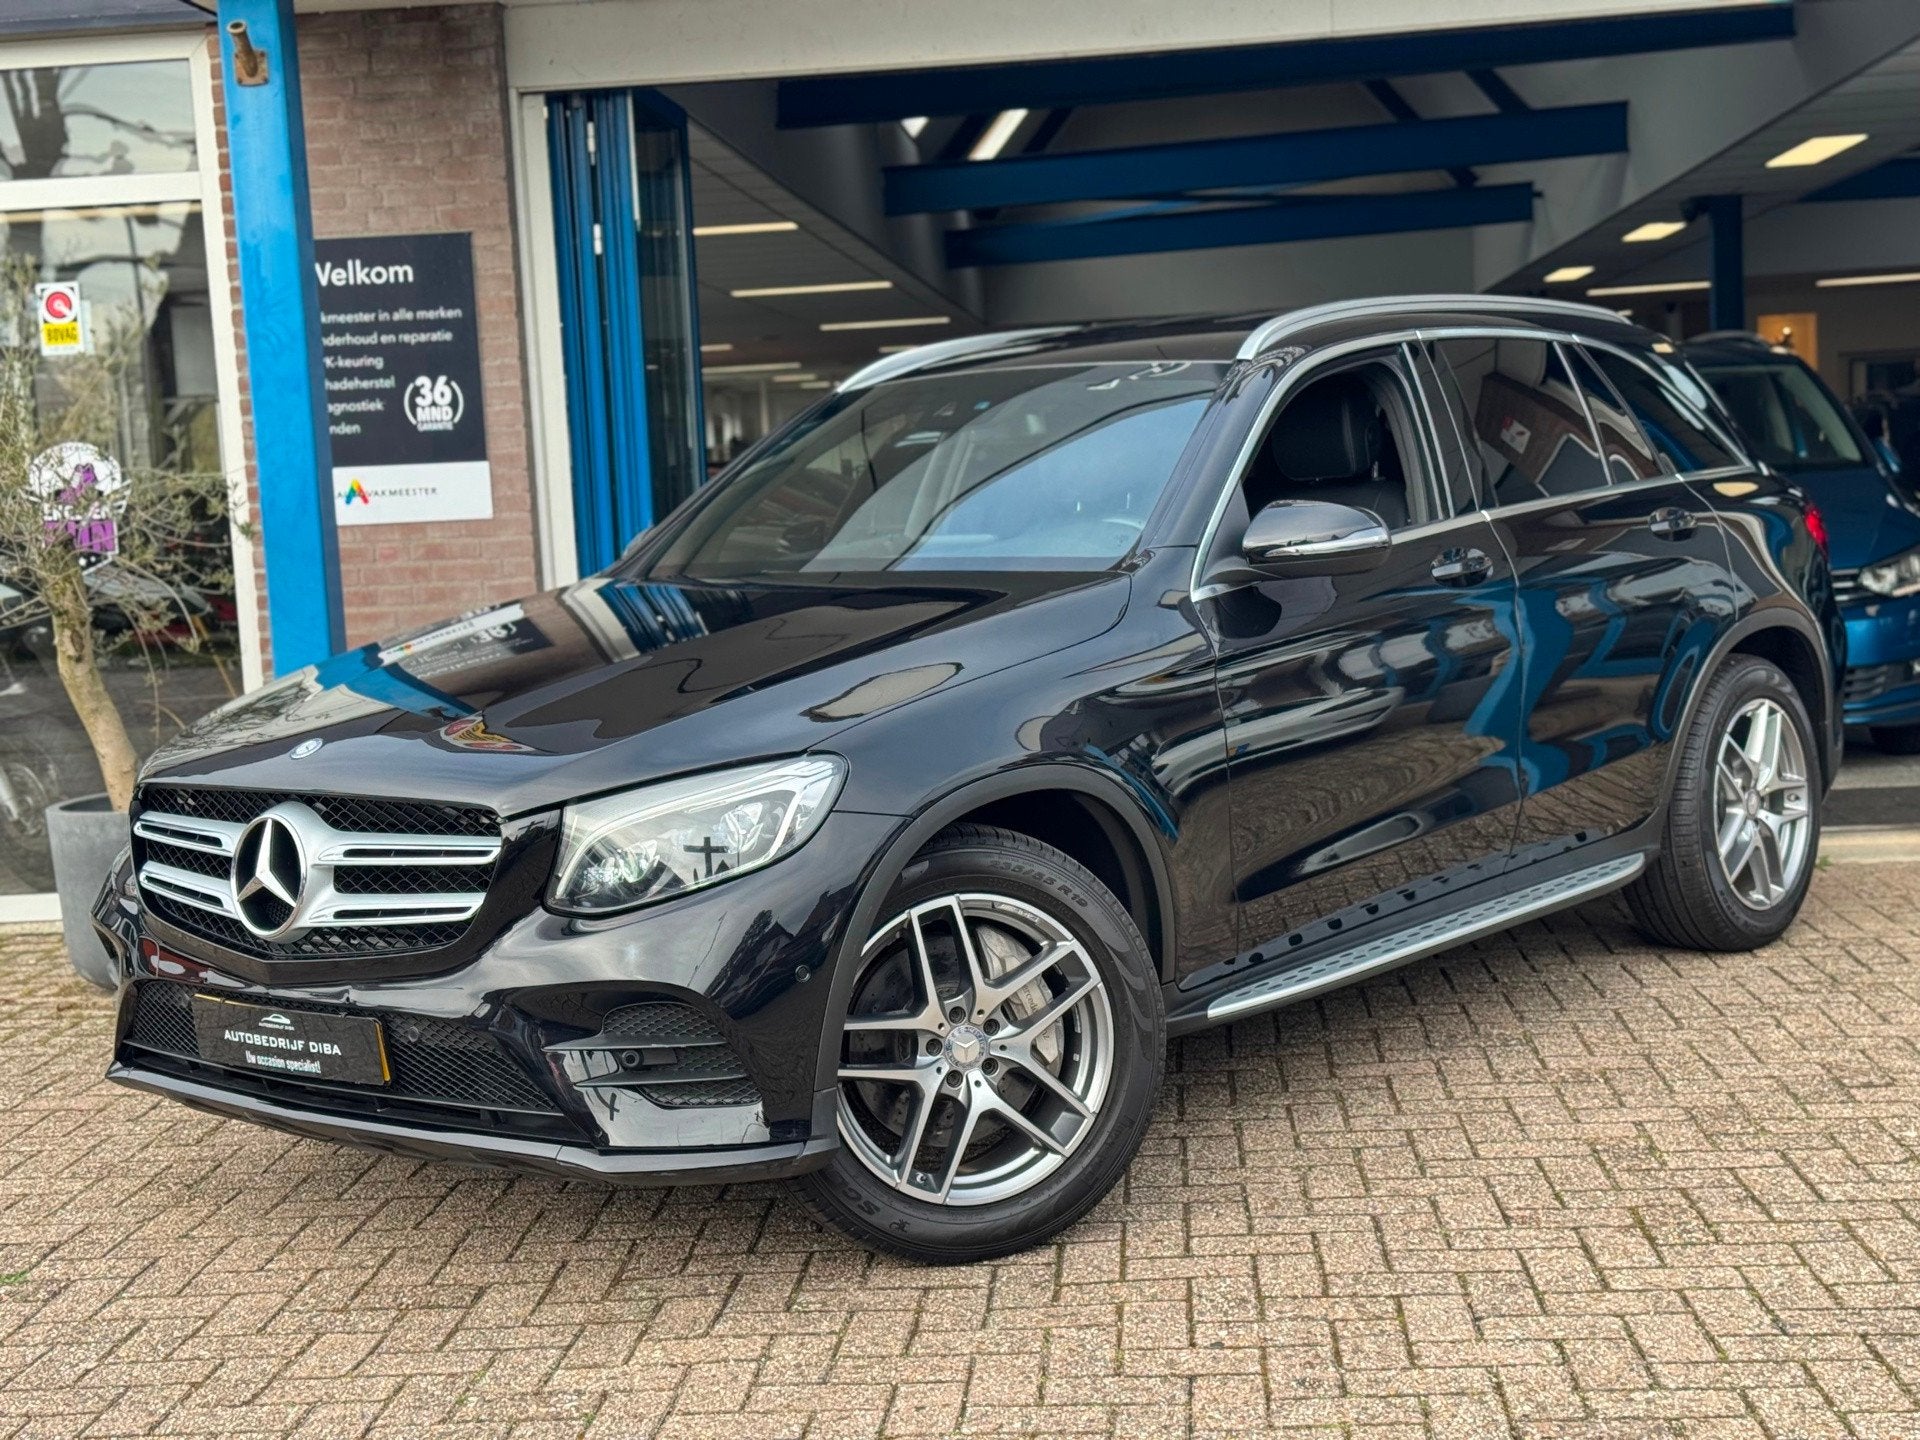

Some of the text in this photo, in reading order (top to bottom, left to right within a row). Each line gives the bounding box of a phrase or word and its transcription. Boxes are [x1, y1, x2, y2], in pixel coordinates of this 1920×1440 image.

[320, 306, 463, 325] kmeester in alle merken
[322, 329, 453, 347] derhoud en reparatie
[323, 354, 384, 370] K-keuring
[325, 375, 396, 392] hadeherstel
[414, 375, 453, 407] 36
[416, 405, 454, 423] MND
[329, 422, 361, 435] nden
[224, 1029, 342, 1056] AUTOBEDRIJF DIBA
[256, 1055, 286, 1069] occasion
